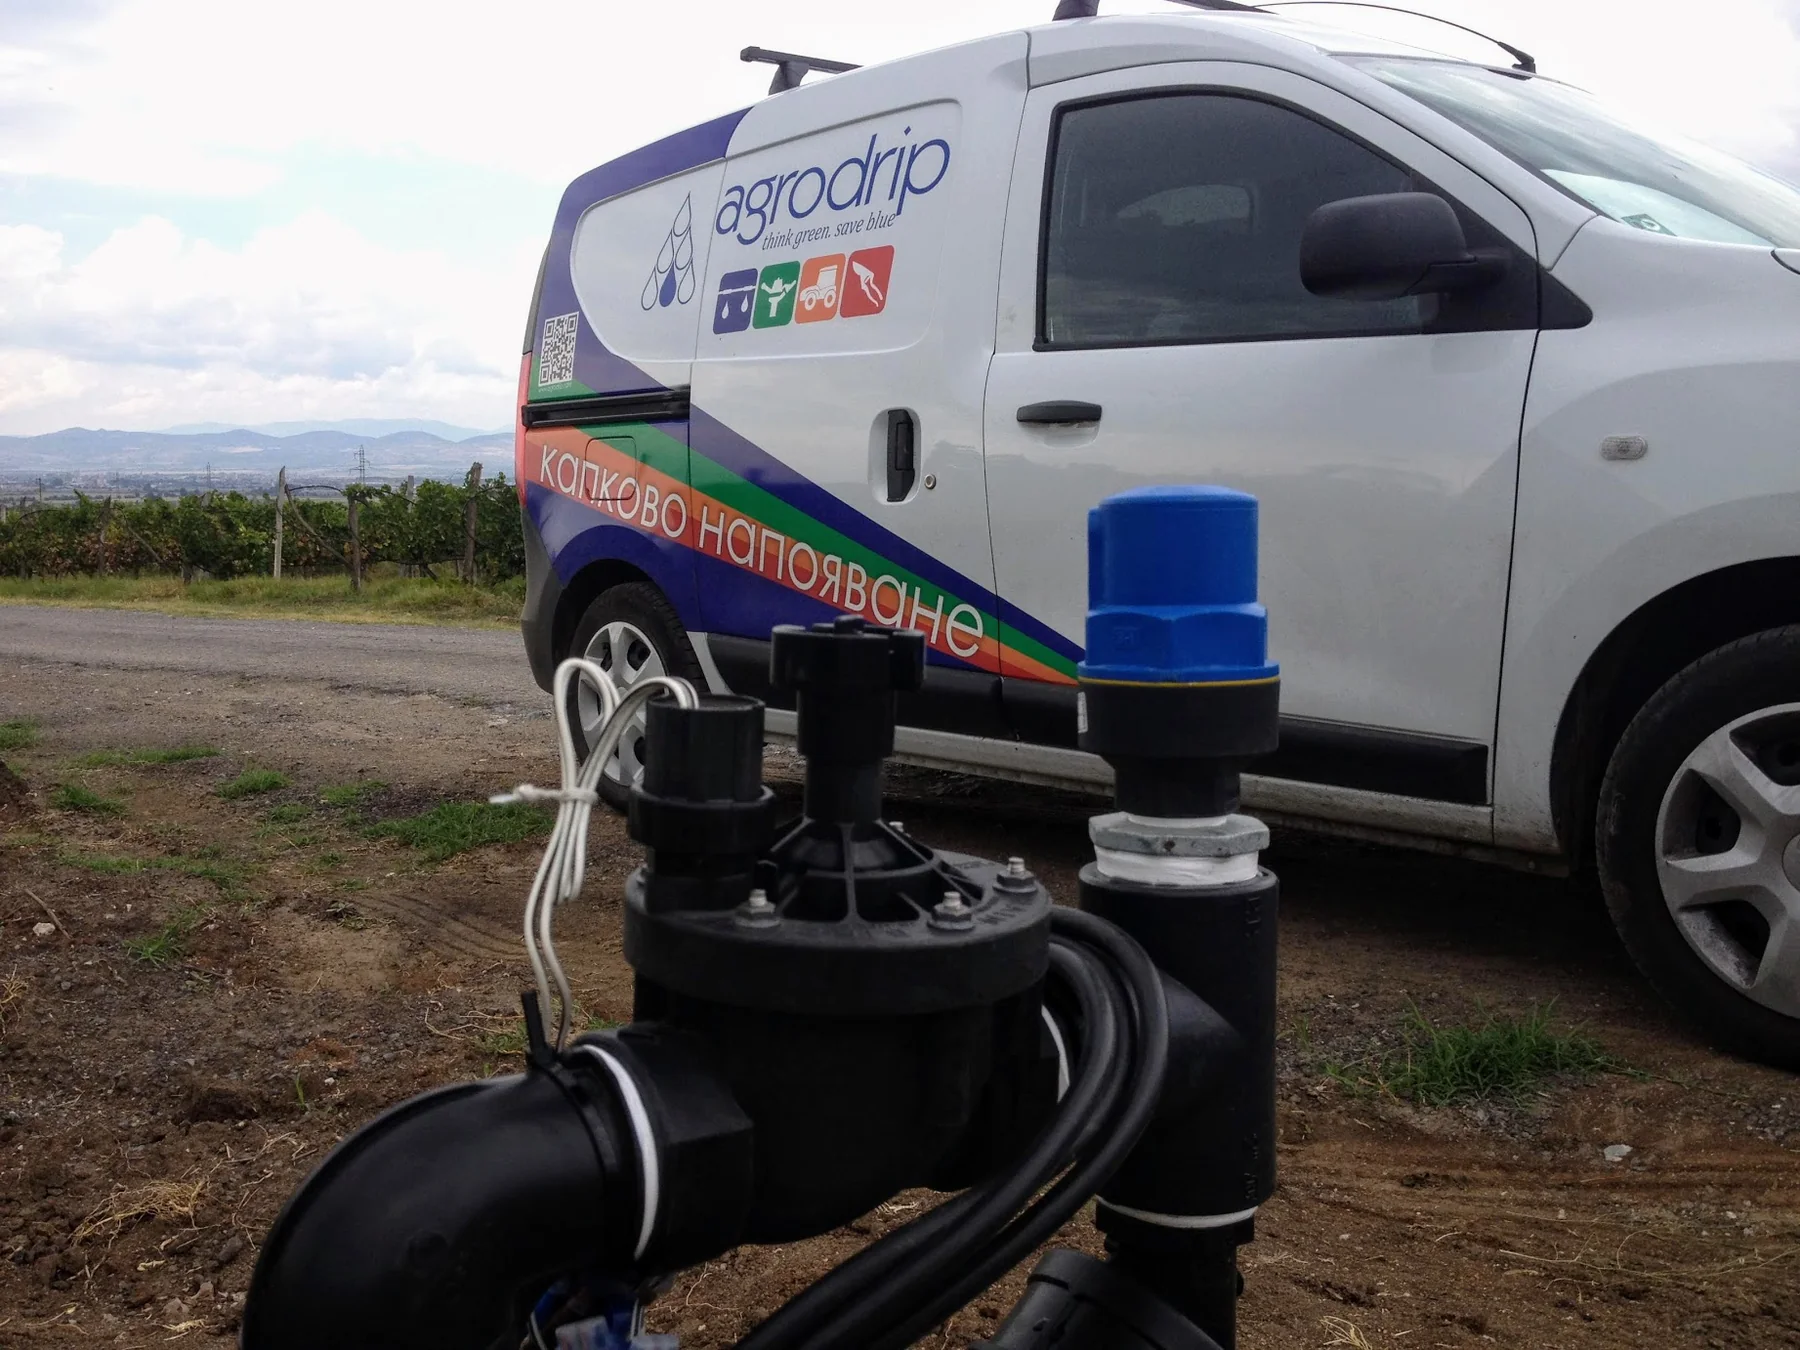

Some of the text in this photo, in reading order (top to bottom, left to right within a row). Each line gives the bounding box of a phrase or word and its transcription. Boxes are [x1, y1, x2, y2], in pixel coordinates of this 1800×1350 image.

[715, 126, 950, 245] agrodrip
[762, 211, 896, 250] think green. save blue
